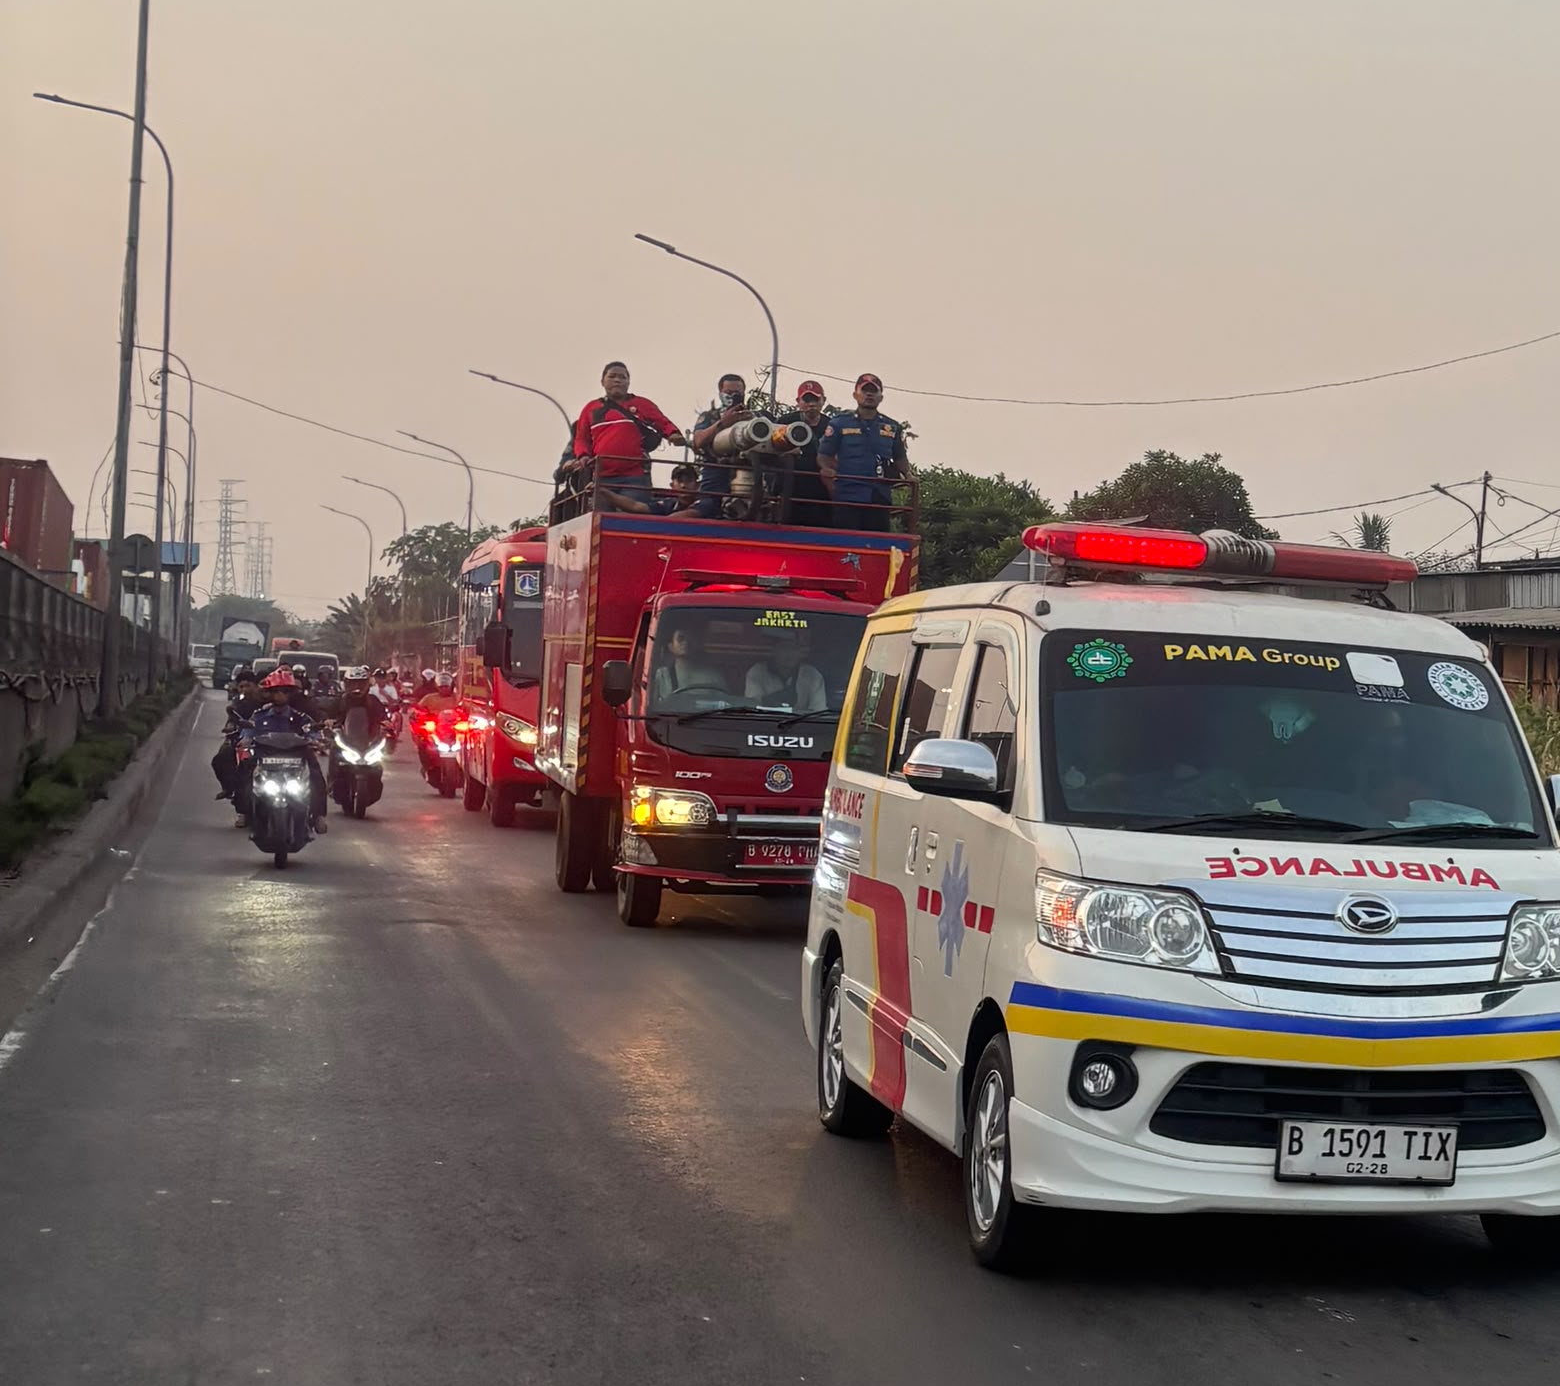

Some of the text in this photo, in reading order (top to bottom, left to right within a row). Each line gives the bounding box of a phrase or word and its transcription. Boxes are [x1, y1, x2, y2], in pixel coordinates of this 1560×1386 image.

[754, 617, 808, 628] JAKARTA
[765, 610, 795, 620] EAST
[1163, 644, 1341, 671] PAMA Group
[1355, 684, 1410, 700] PAMA
[747, 734, 814, 749] ISUZU
[748, 844, 756, 858] B
[761, 844, 792, 858] 9278
[1287, 1125, 1452, 1162] B 1591 TIX
